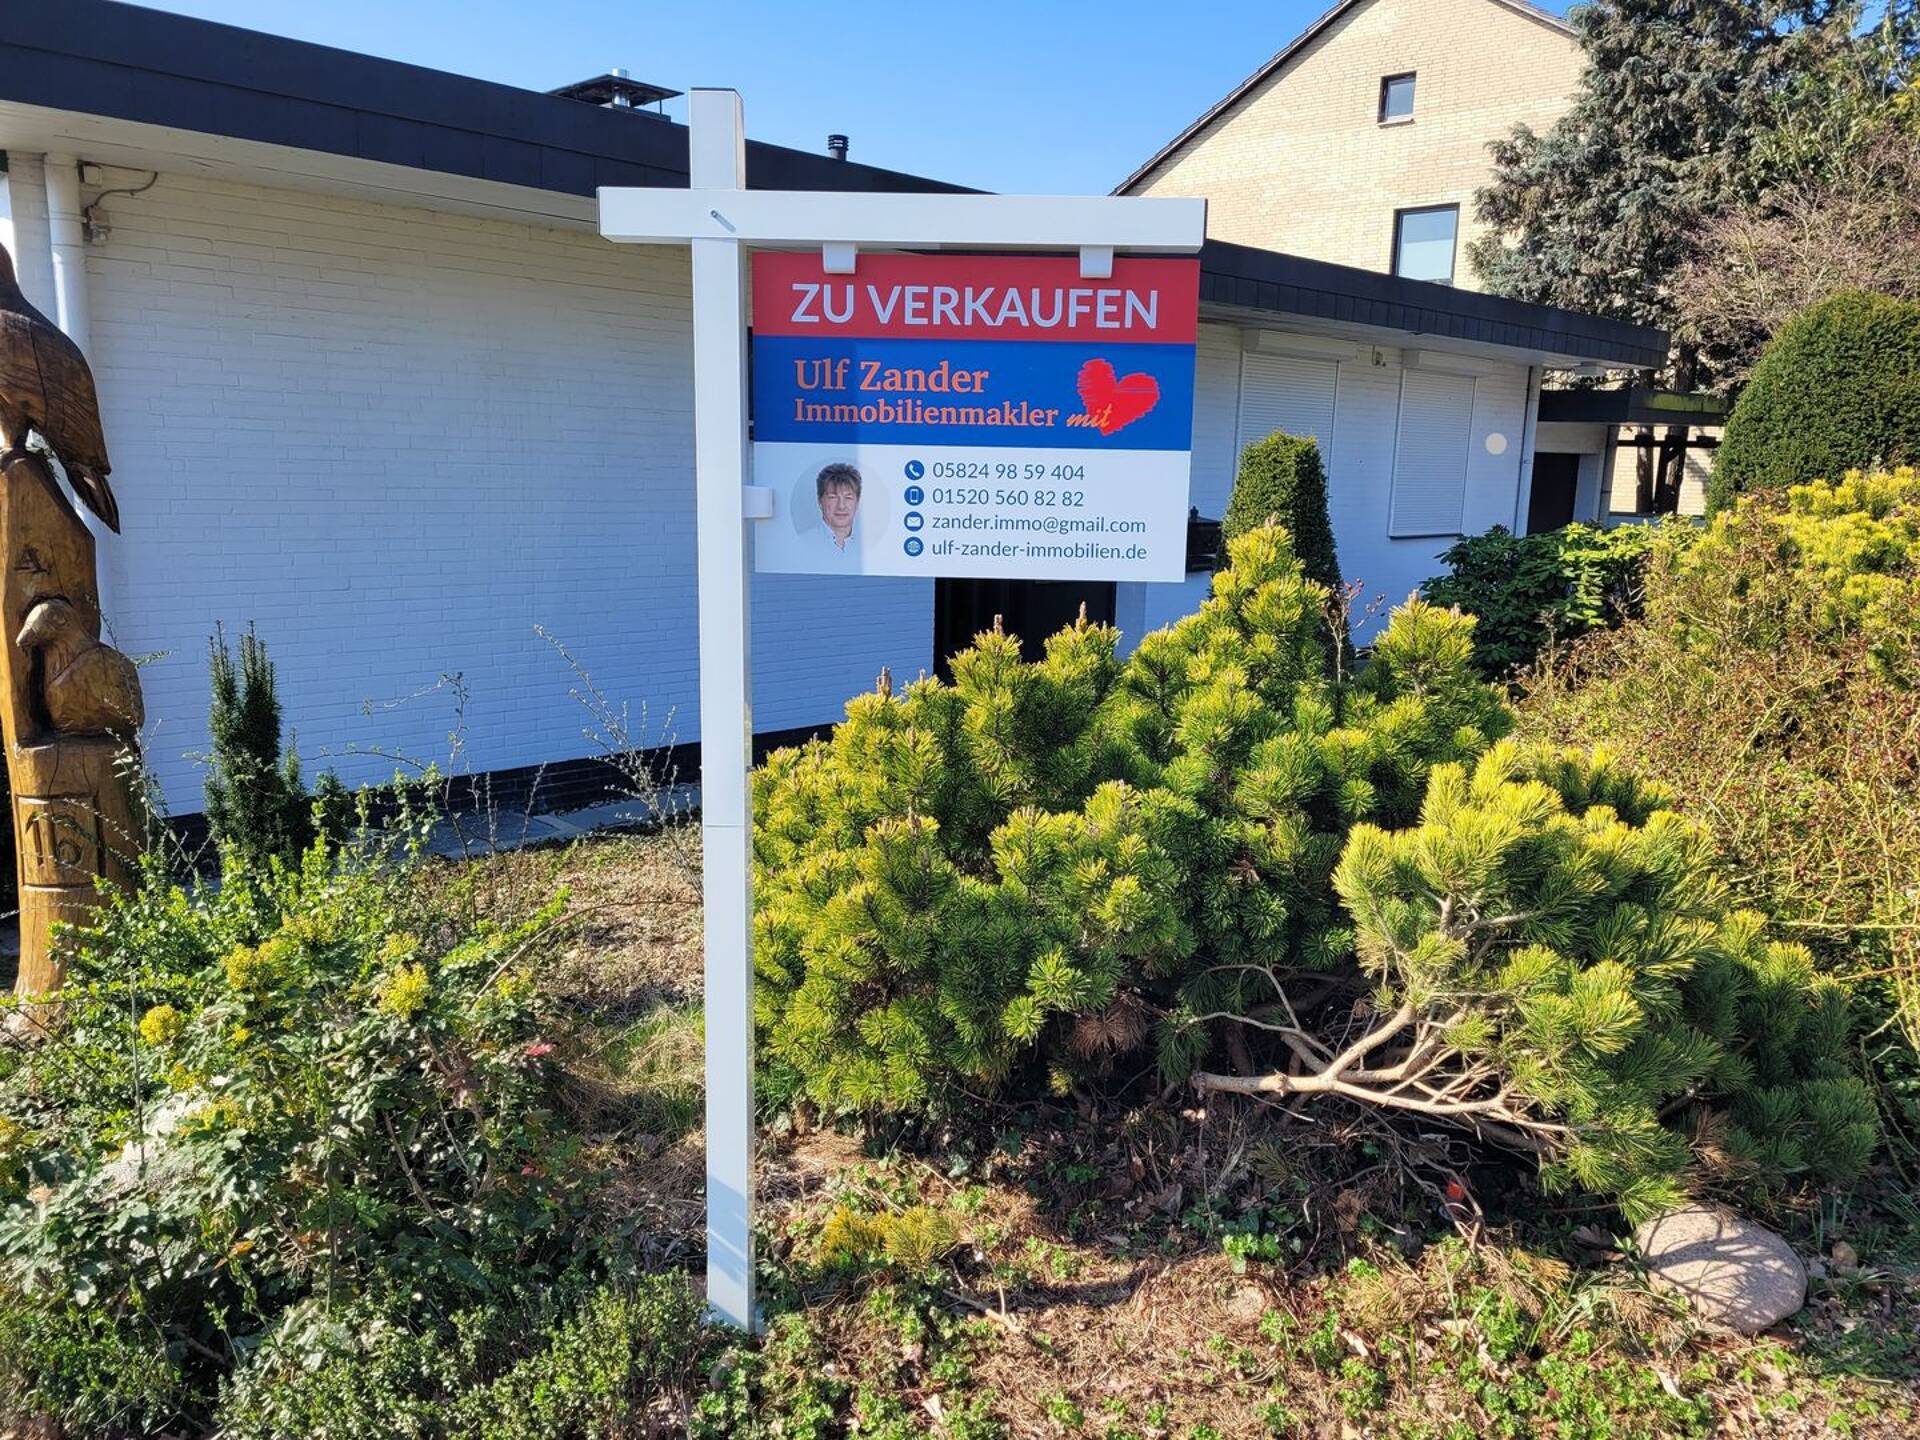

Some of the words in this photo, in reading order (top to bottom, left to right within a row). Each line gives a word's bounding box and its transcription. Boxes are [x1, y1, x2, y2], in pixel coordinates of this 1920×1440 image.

[791, 283, 855, 324] ZU
[866, 285, 1158, 329] VERKAUFEN
[794, 358, 850, 391] Ulf
[859, 361, 990, 393] Zander
[794, 398, 1060, 427] Immobilienmakler
[1066, 403, 1112, 429] mit
[932, 462, 990, 479] 05824
[995, 463, 1018, 480] 98
[1023, 464, 1045, 480] 59
[1050, 465, 1085, 481] 404
[932, 488, 989, 505] 01520
[995, 489, 1029, 506] 560
[1034, 490, 1056, 507] 82
[1062, 491, 1084, 508] 82
[932, 514, 1146, 535] zander.immo@gmail.com
[932, 539, 1147, 560] ulf-zander-immobilien.de
